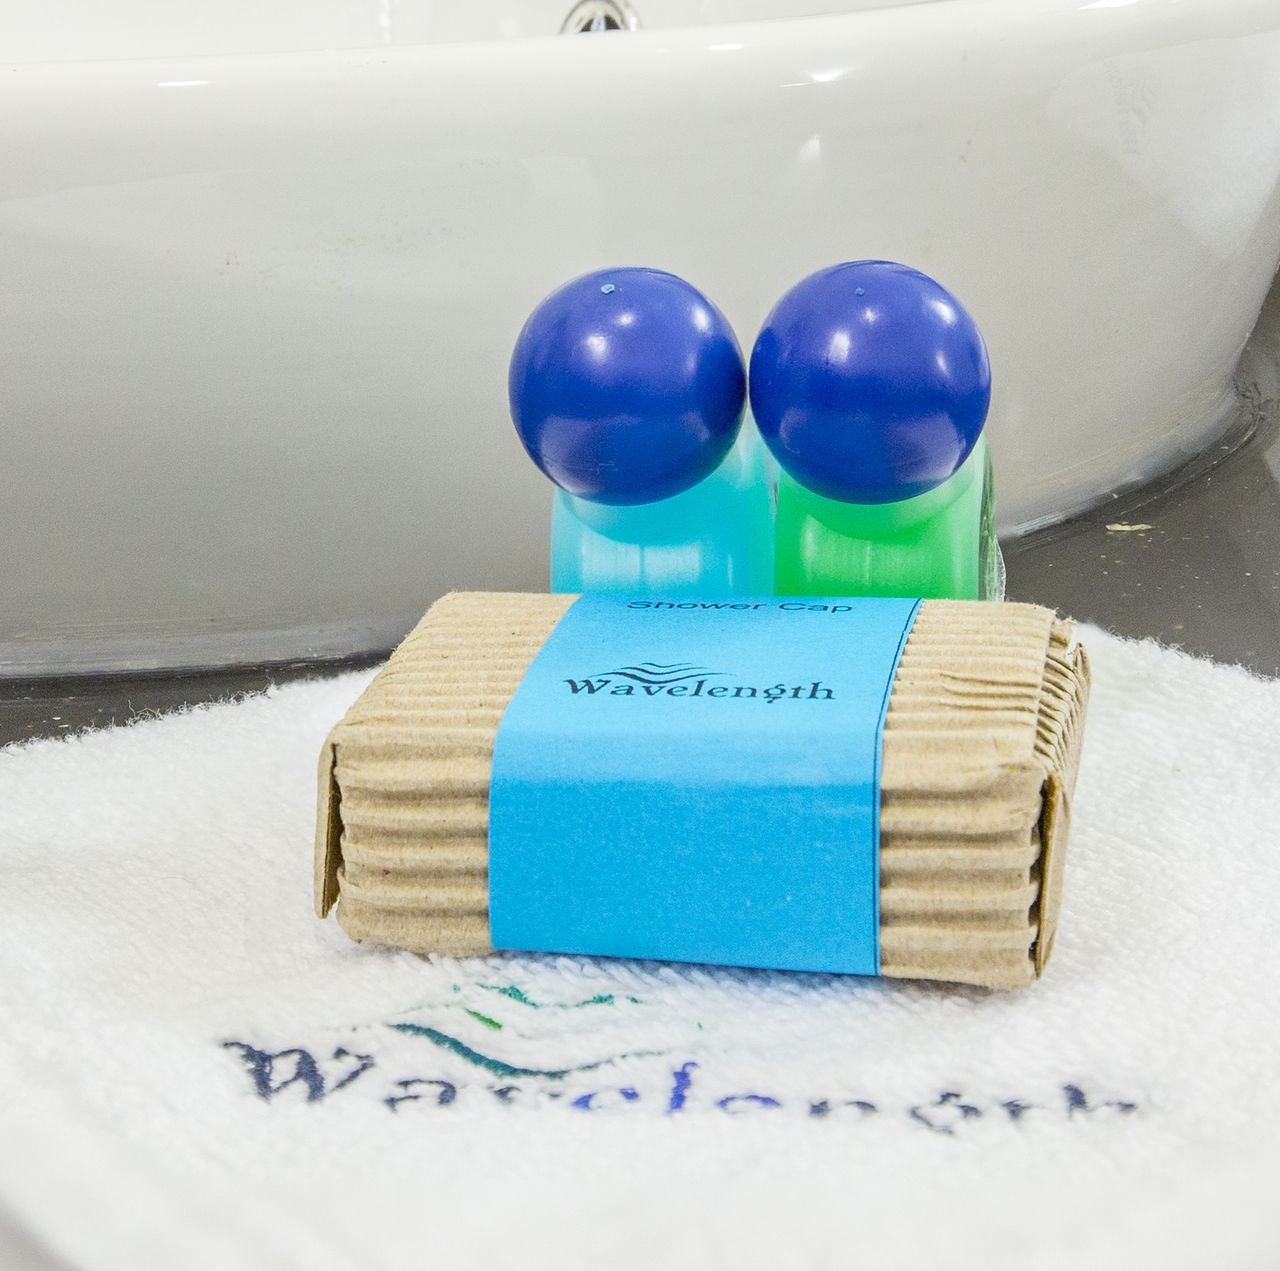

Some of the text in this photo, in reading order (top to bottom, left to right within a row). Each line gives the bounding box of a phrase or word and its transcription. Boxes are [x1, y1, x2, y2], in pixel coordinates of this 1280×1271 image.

[626, 600, 853, 614] Shower Cap
[564, 678, 836, 704] Wavelength
